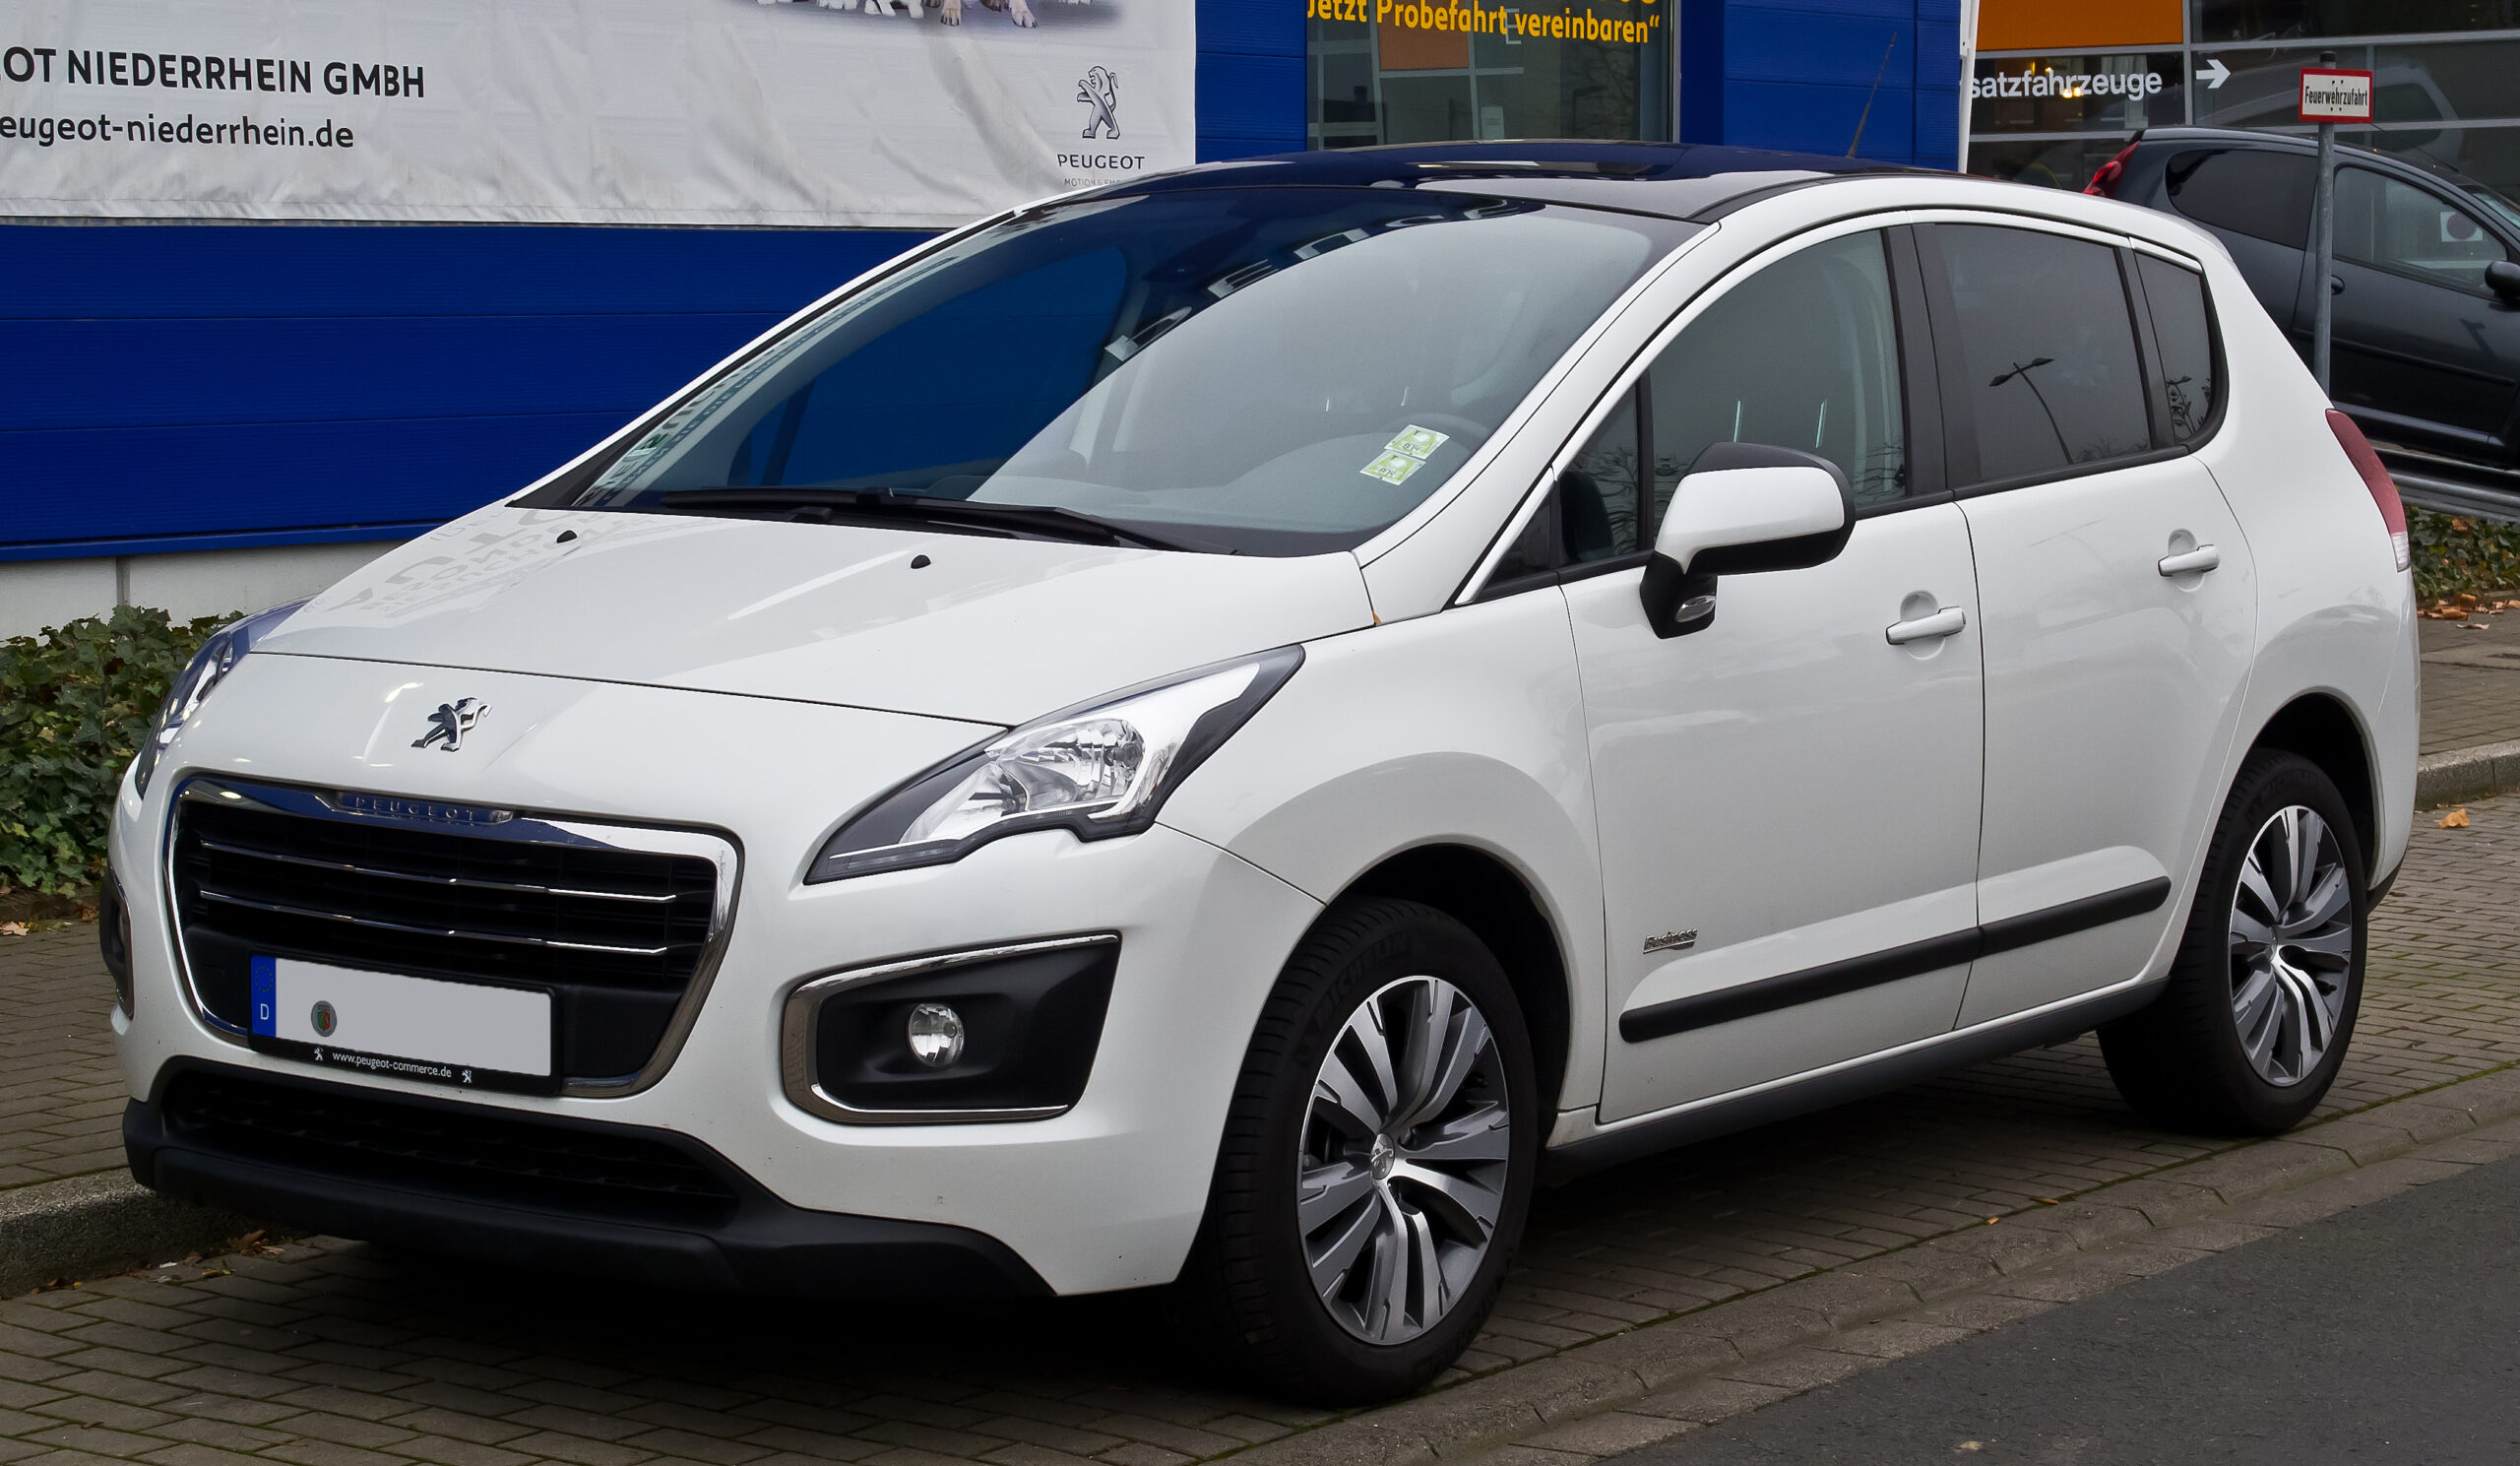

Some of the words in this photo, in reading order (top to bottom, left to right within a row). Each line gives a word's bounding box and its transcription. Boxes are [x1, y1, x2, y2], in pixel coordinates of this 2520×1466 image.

[1377, 0, 1508, 34] Probefahrt
[67, 50, 312, 94] NIEDERRHEIN
[323, 62, 424, 97] GMBH
[2304, 86, 2368, 106] Feuerwehrzufahrt
[0, 112, 354, 149] eugeot-niederrhein.de
[1057, 154, 1146, 170] PEUGEOT
[355, 796, 473, 821] PEUGEOT
[259, 1002, 270, 1021] D
[332, 1050, 452, 1078] www.peugeot-commerce.de
